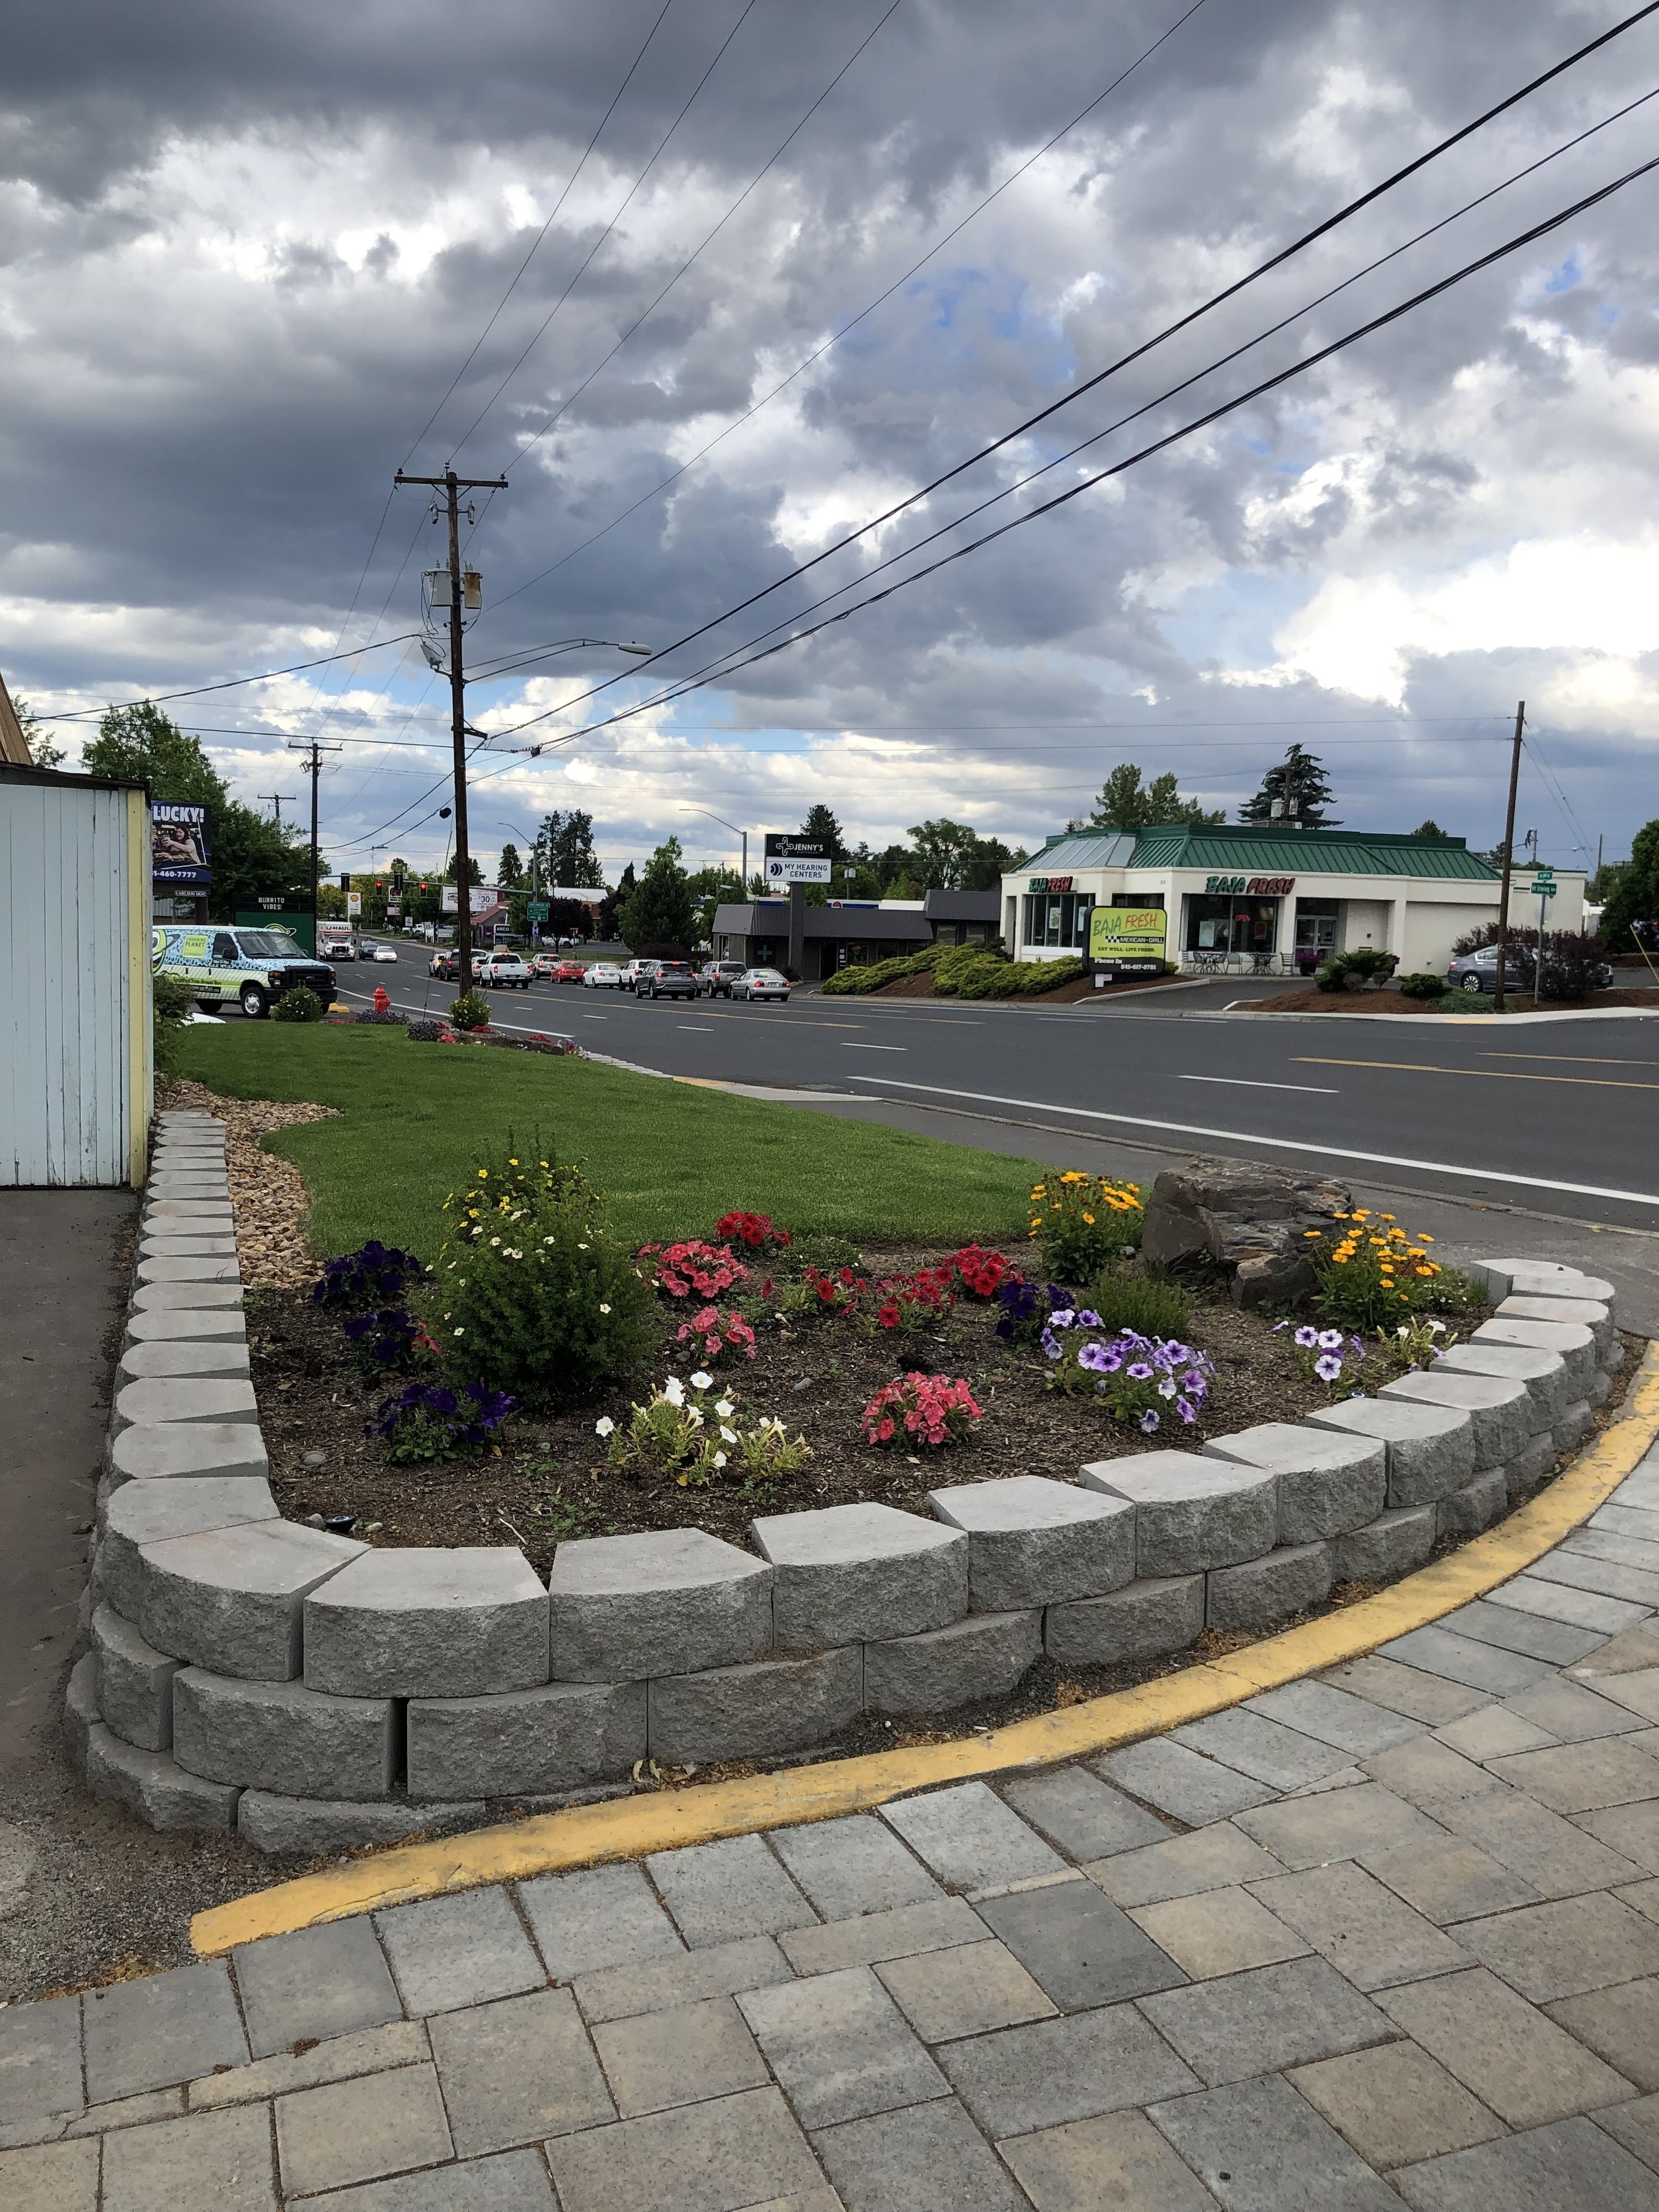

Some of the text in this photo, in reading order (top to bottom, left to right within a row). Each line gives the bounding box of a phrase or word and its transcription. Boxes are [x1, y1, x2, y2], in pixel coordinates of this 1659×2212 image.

[153, 805, 204, 823] LUCKY!
[794, 843, 824, 851] JENNY'S
[1028, 876, 1073, 892] BAJA FRESH
[1205, 876, 1296, 895] BAJA FRESH
[1093, 912, 1157, 937] BAJA FRESH
